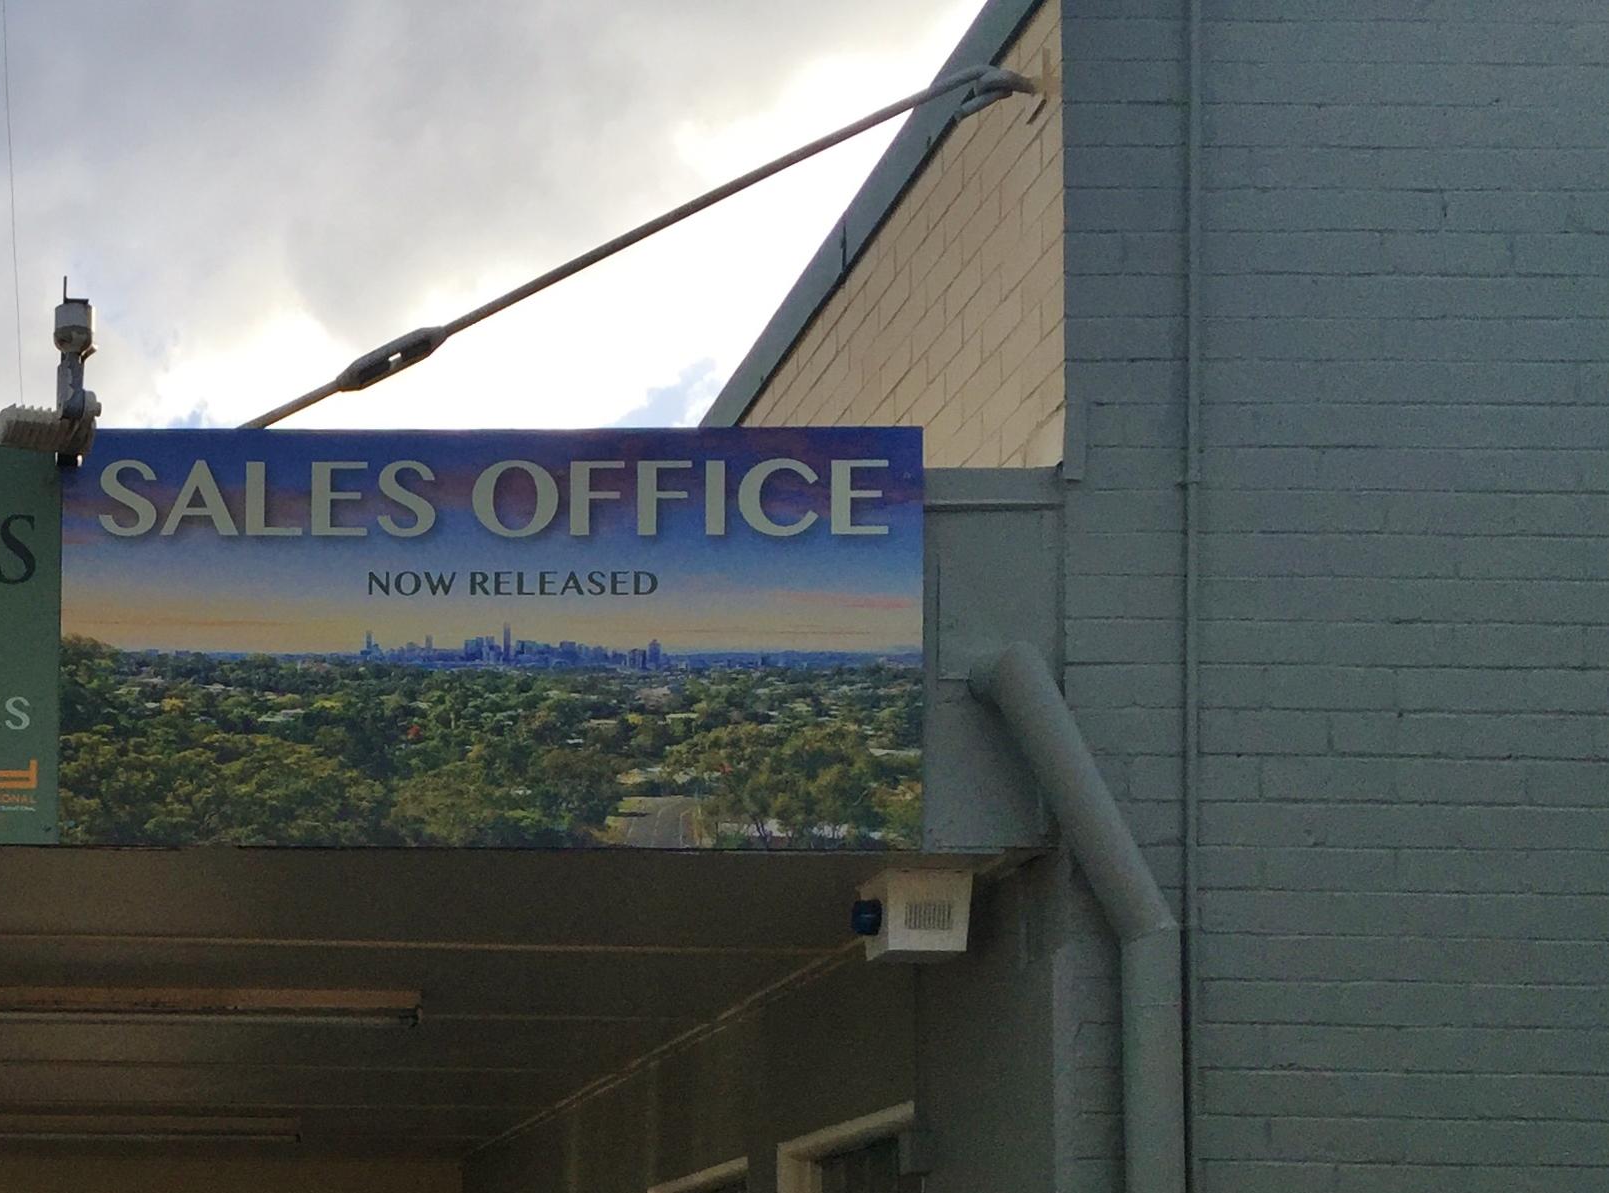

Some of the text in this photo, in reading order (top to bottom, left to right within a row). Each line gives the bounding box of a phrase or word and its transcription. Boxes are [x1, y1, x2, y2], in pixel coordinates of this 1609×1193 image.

[98, 458, 889, 538] SALES OFFICE
[367, 570, 658, 597] NOW RELEASED
